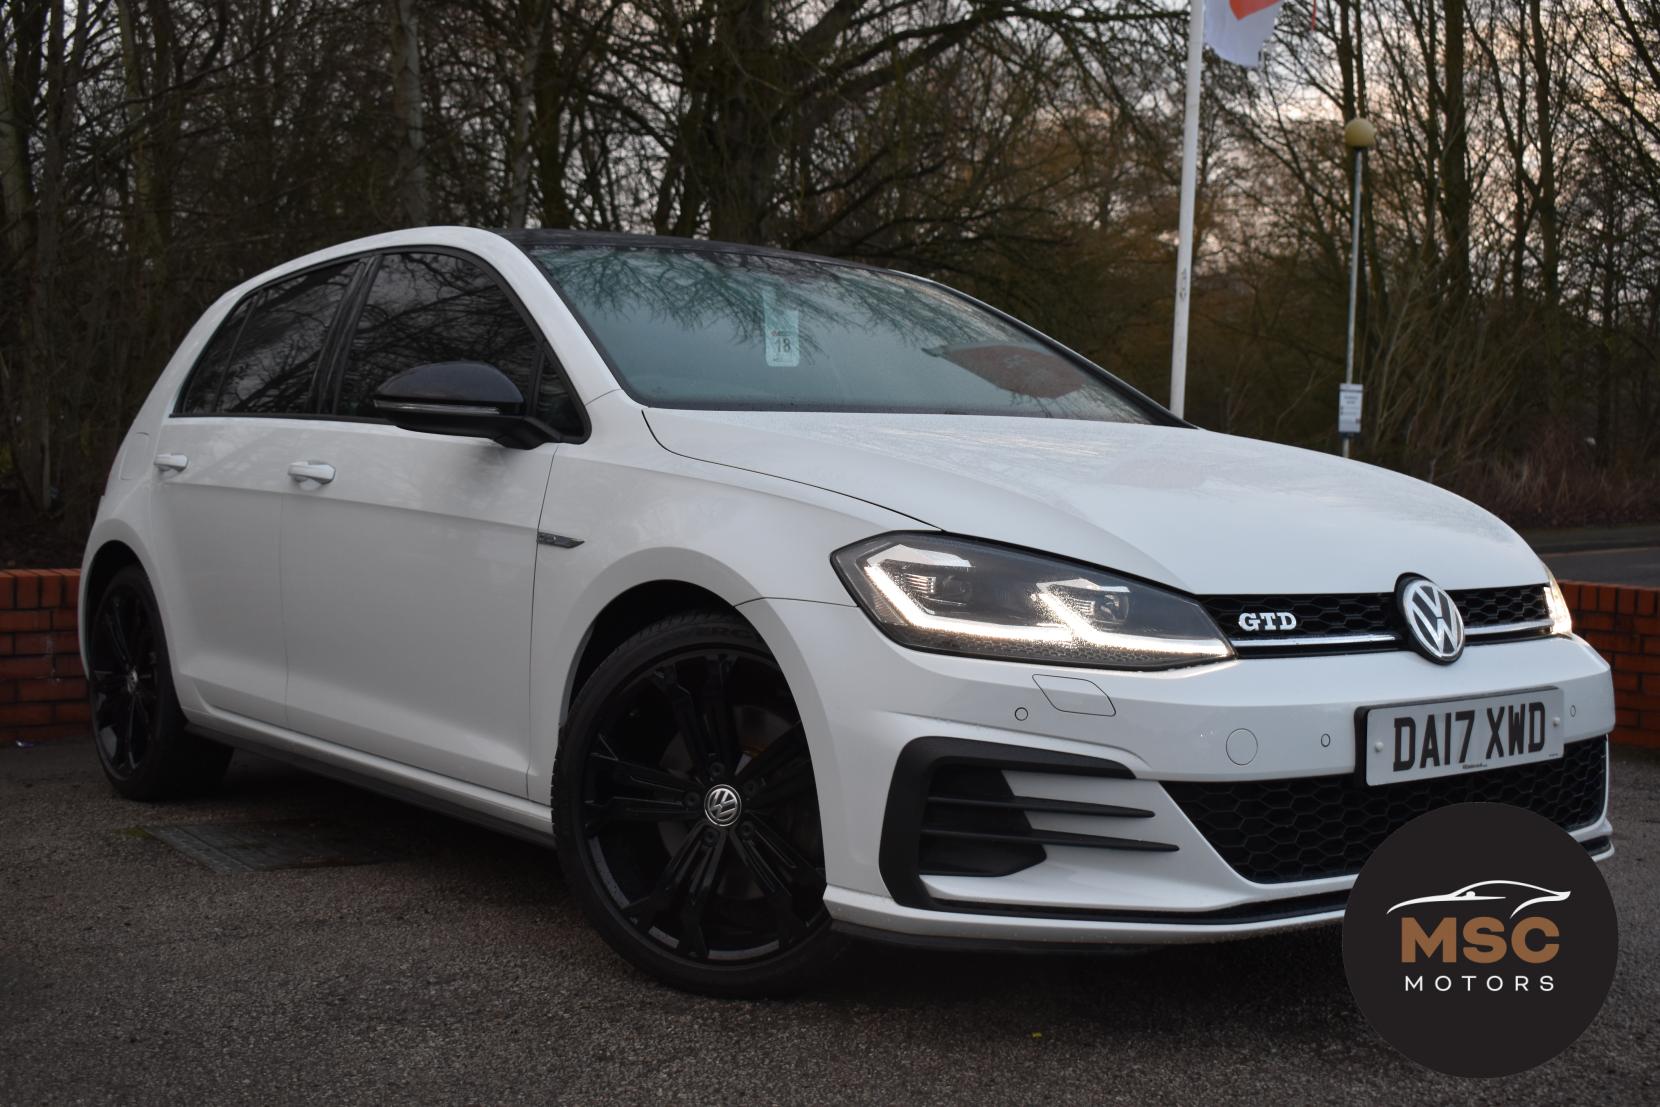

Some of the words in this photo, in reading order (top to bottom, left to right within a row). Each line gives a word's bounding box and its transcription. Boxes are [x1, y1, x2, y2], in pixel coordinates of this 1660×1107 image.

[1238, 612, 1297, 631] GTD
[1393, 710, 1475, 772] DA17
[1485, 702, 1546, 760] XWD
